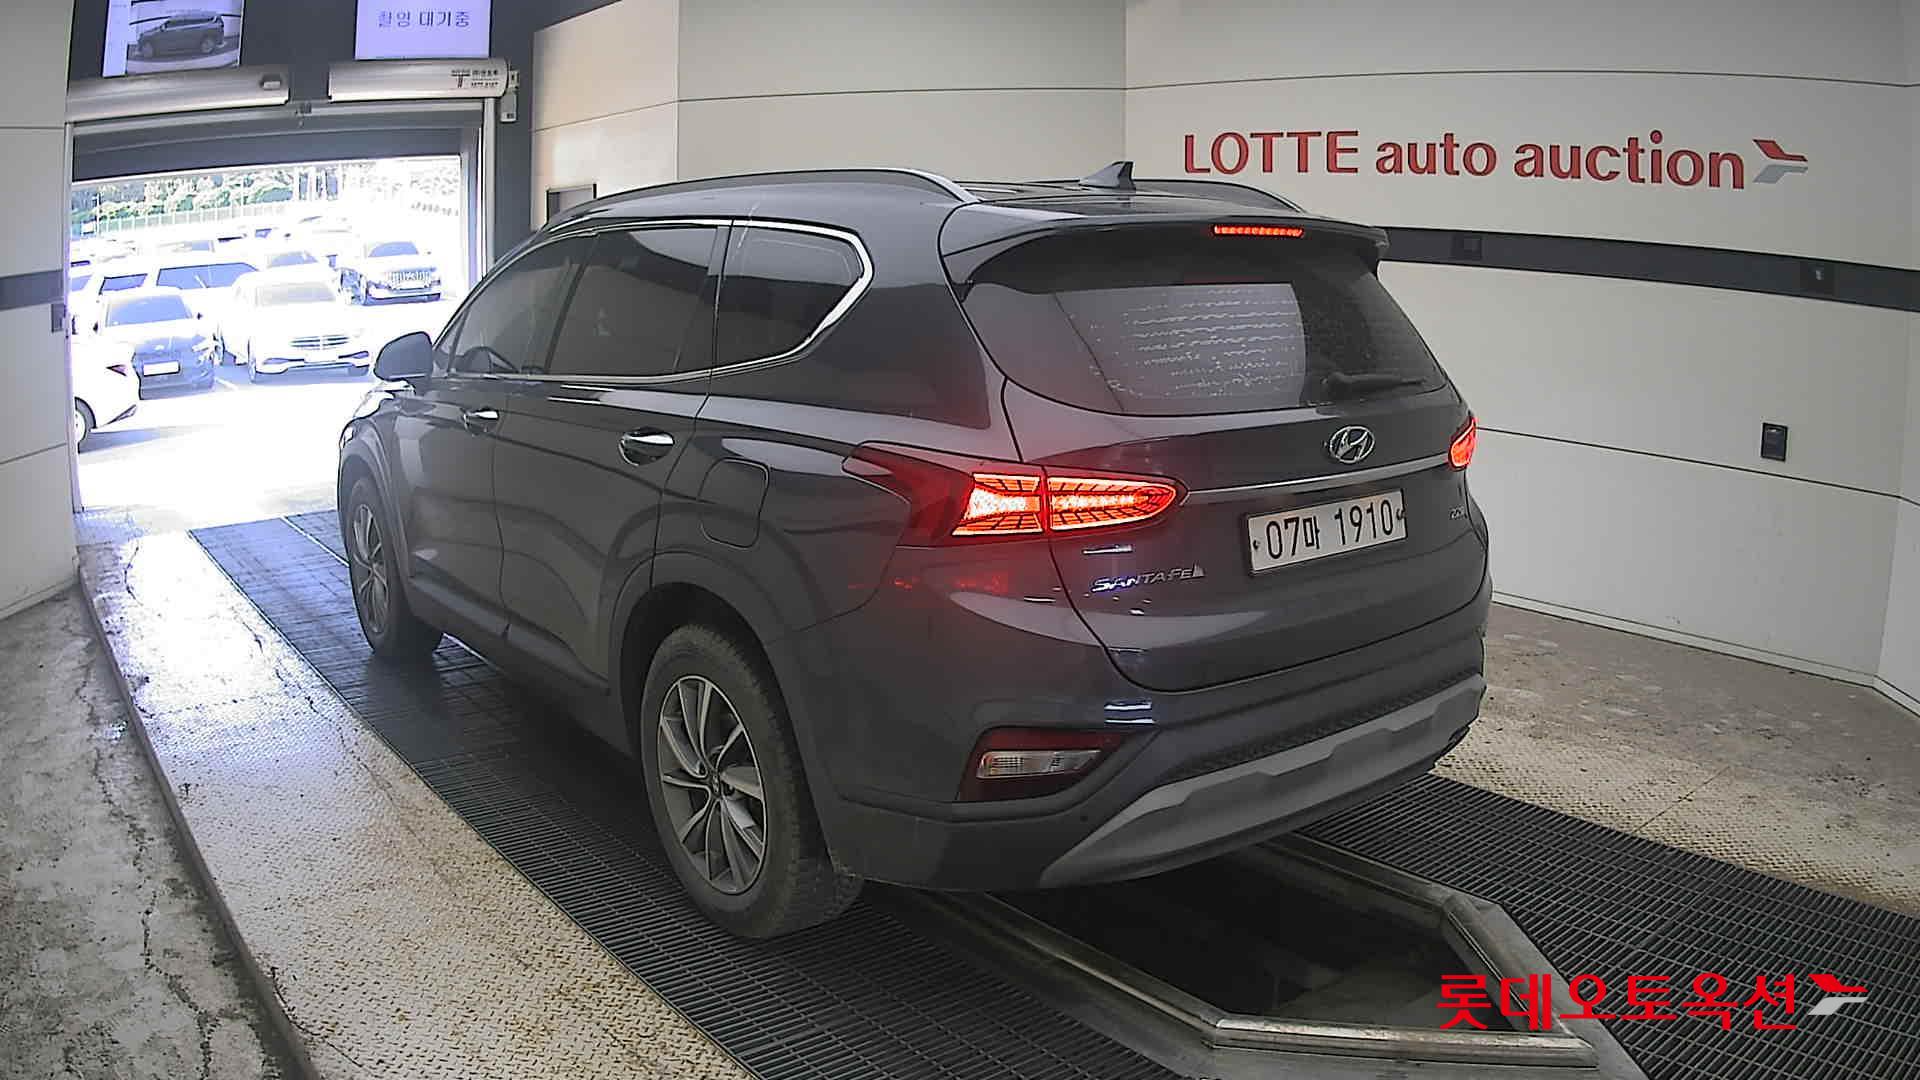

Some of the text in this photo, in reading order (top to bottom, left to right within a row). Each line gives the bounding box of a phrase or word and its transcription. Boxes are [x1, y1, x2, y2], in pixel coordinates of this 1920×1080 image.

[419, 10, 470, 28] 대기중
[1184, 130, 1745, 189] LOTTE auto auction
[1265, 499, 1395, 560] 07마 1910
